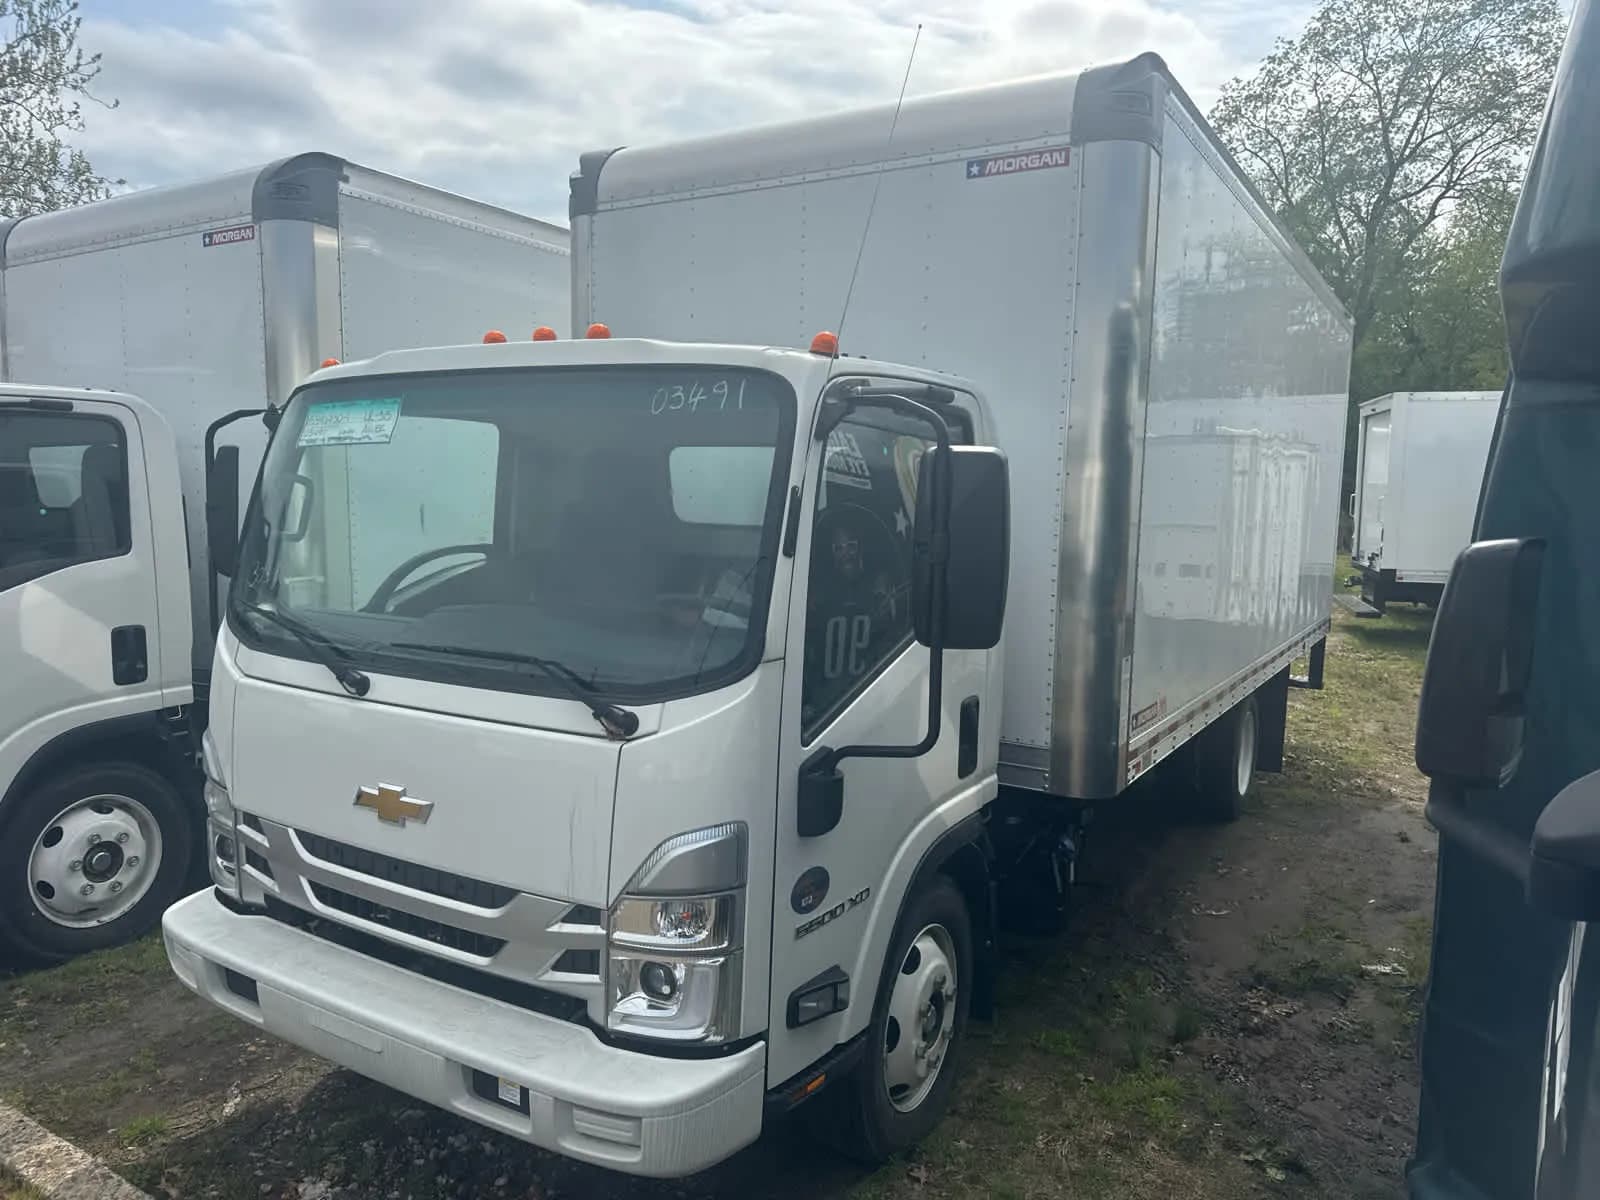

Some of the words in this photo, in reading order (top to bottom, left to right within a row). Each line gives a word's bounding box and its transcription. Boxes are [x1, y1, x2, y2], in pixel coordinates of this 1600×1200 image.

[984, 151, 1066, 176] MORGAN
[212, 227, 252, 244] MORGAN
[651, 378, 747, 415] 03491
